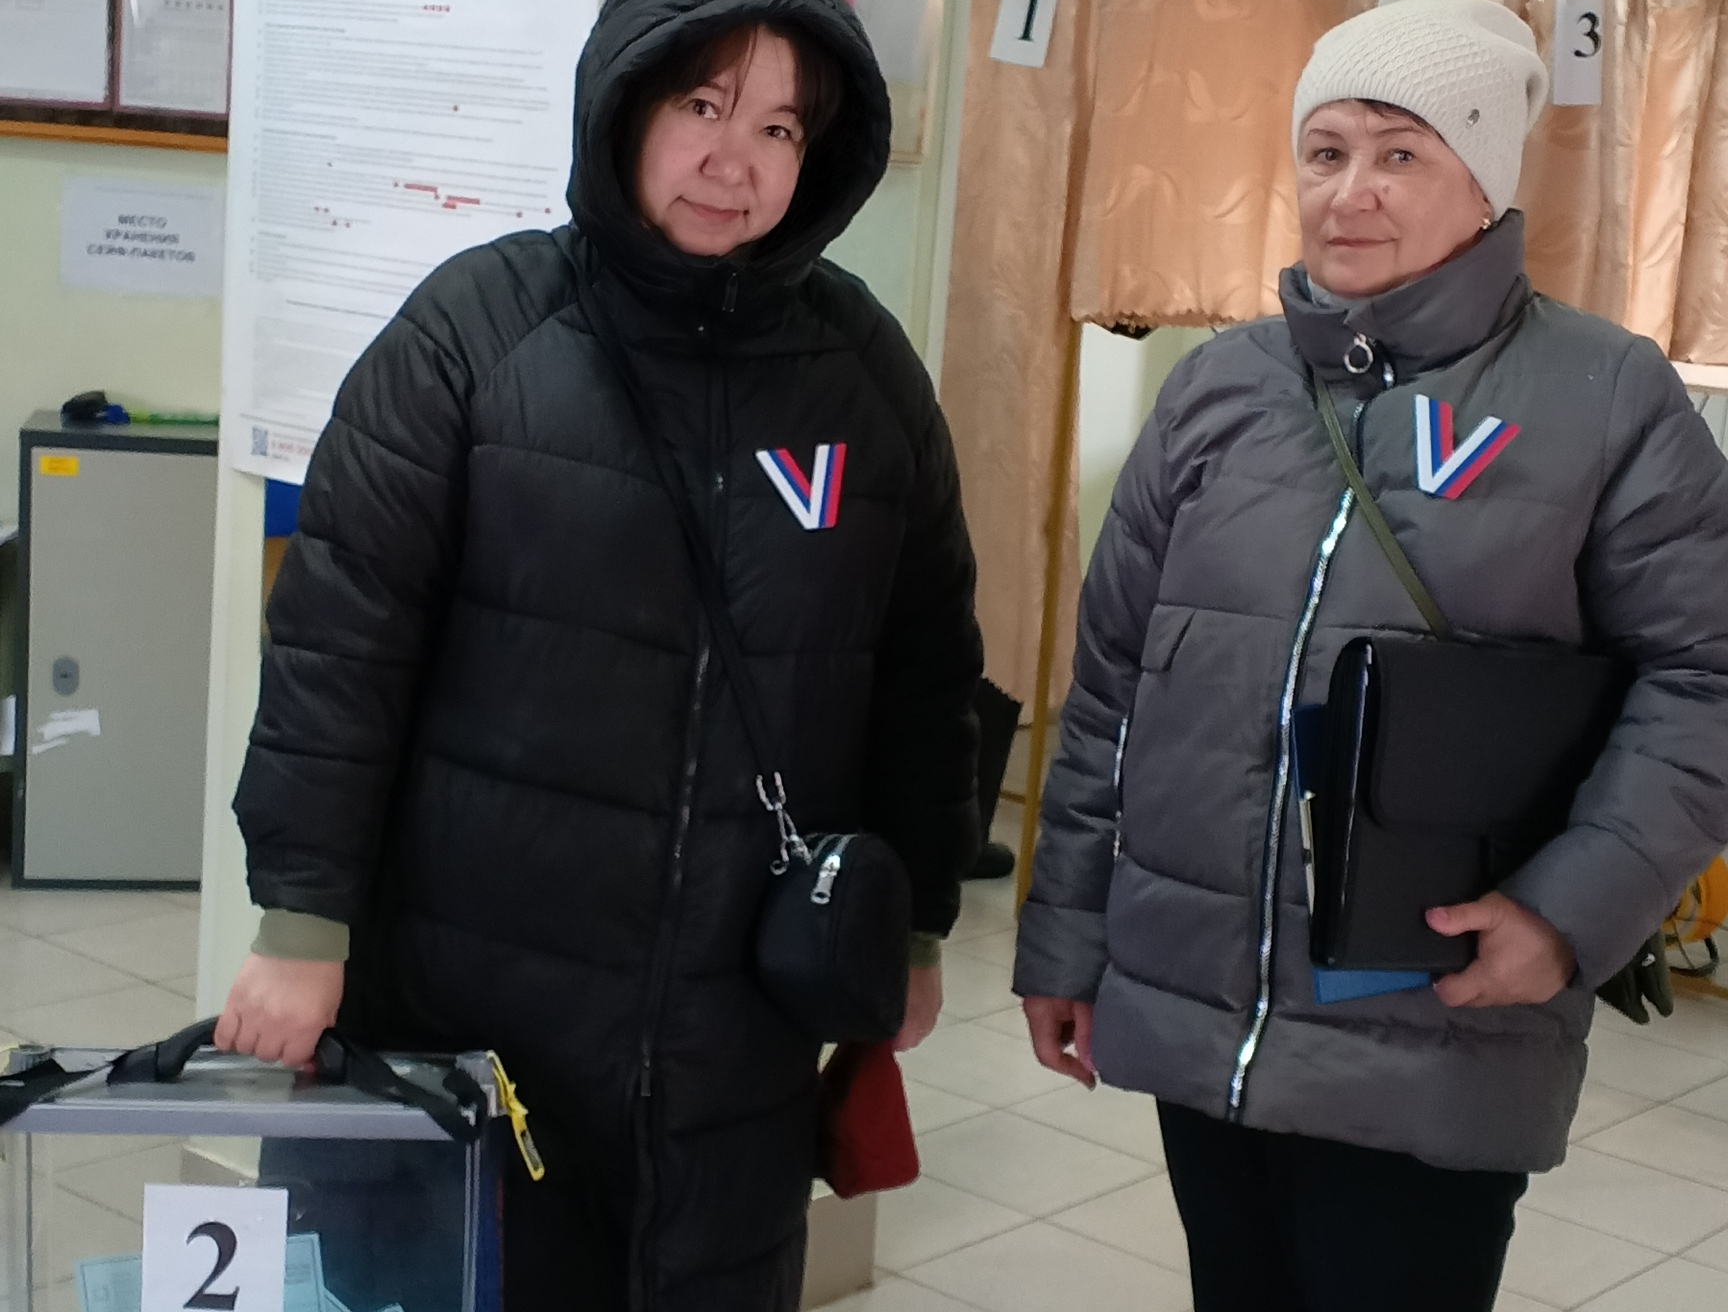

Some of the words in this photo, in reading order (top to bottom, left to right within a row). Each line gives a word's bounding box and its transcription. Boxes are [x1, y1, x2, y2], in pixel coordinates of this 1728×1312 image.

[1573, 11, 1602, 59] 3
[754, 442, 848, 530] V
[1414, 393, 1521, 501] V
[183, 1221, 240, 1312] 2
